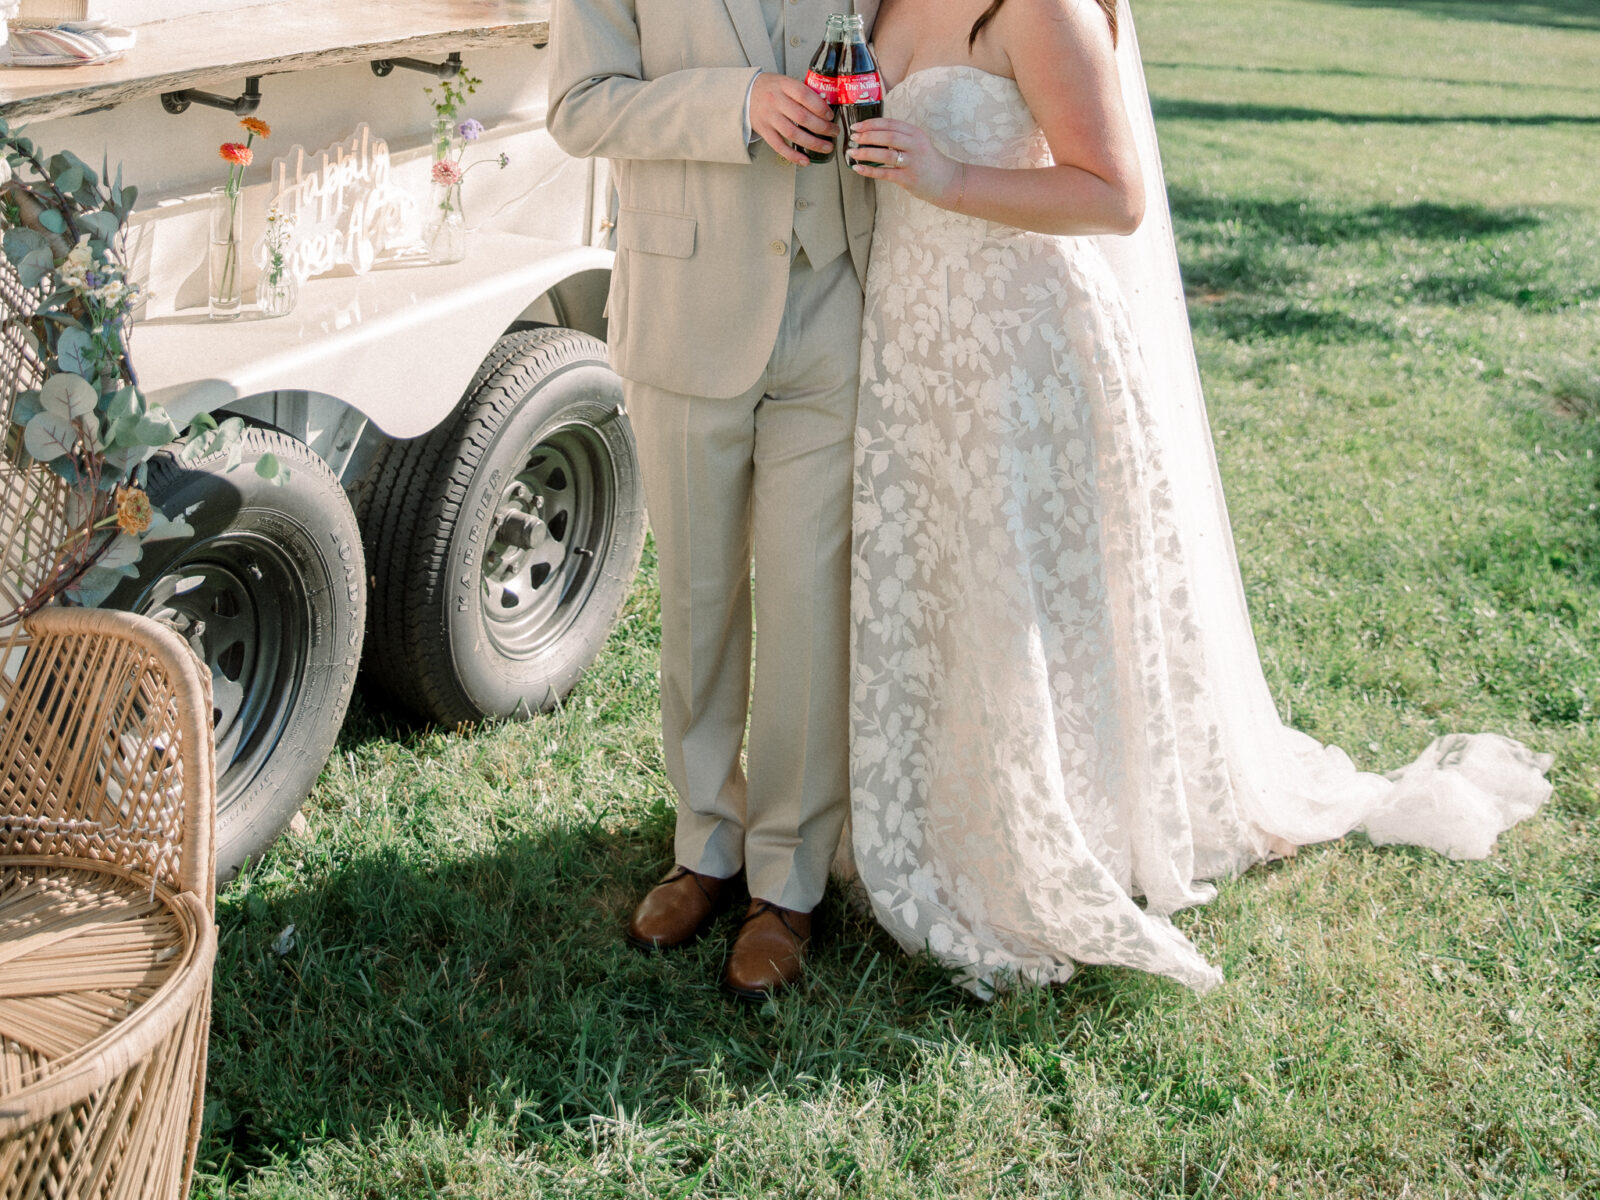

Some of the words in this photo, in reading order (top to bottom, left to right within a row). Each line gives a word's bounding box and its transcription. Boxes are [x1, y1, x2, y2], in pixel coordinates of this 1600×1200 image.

[844, 82, 858, 91] The
[270, 126, 391, 225] Happily
[456, 468, 502, 613] KARRIER
